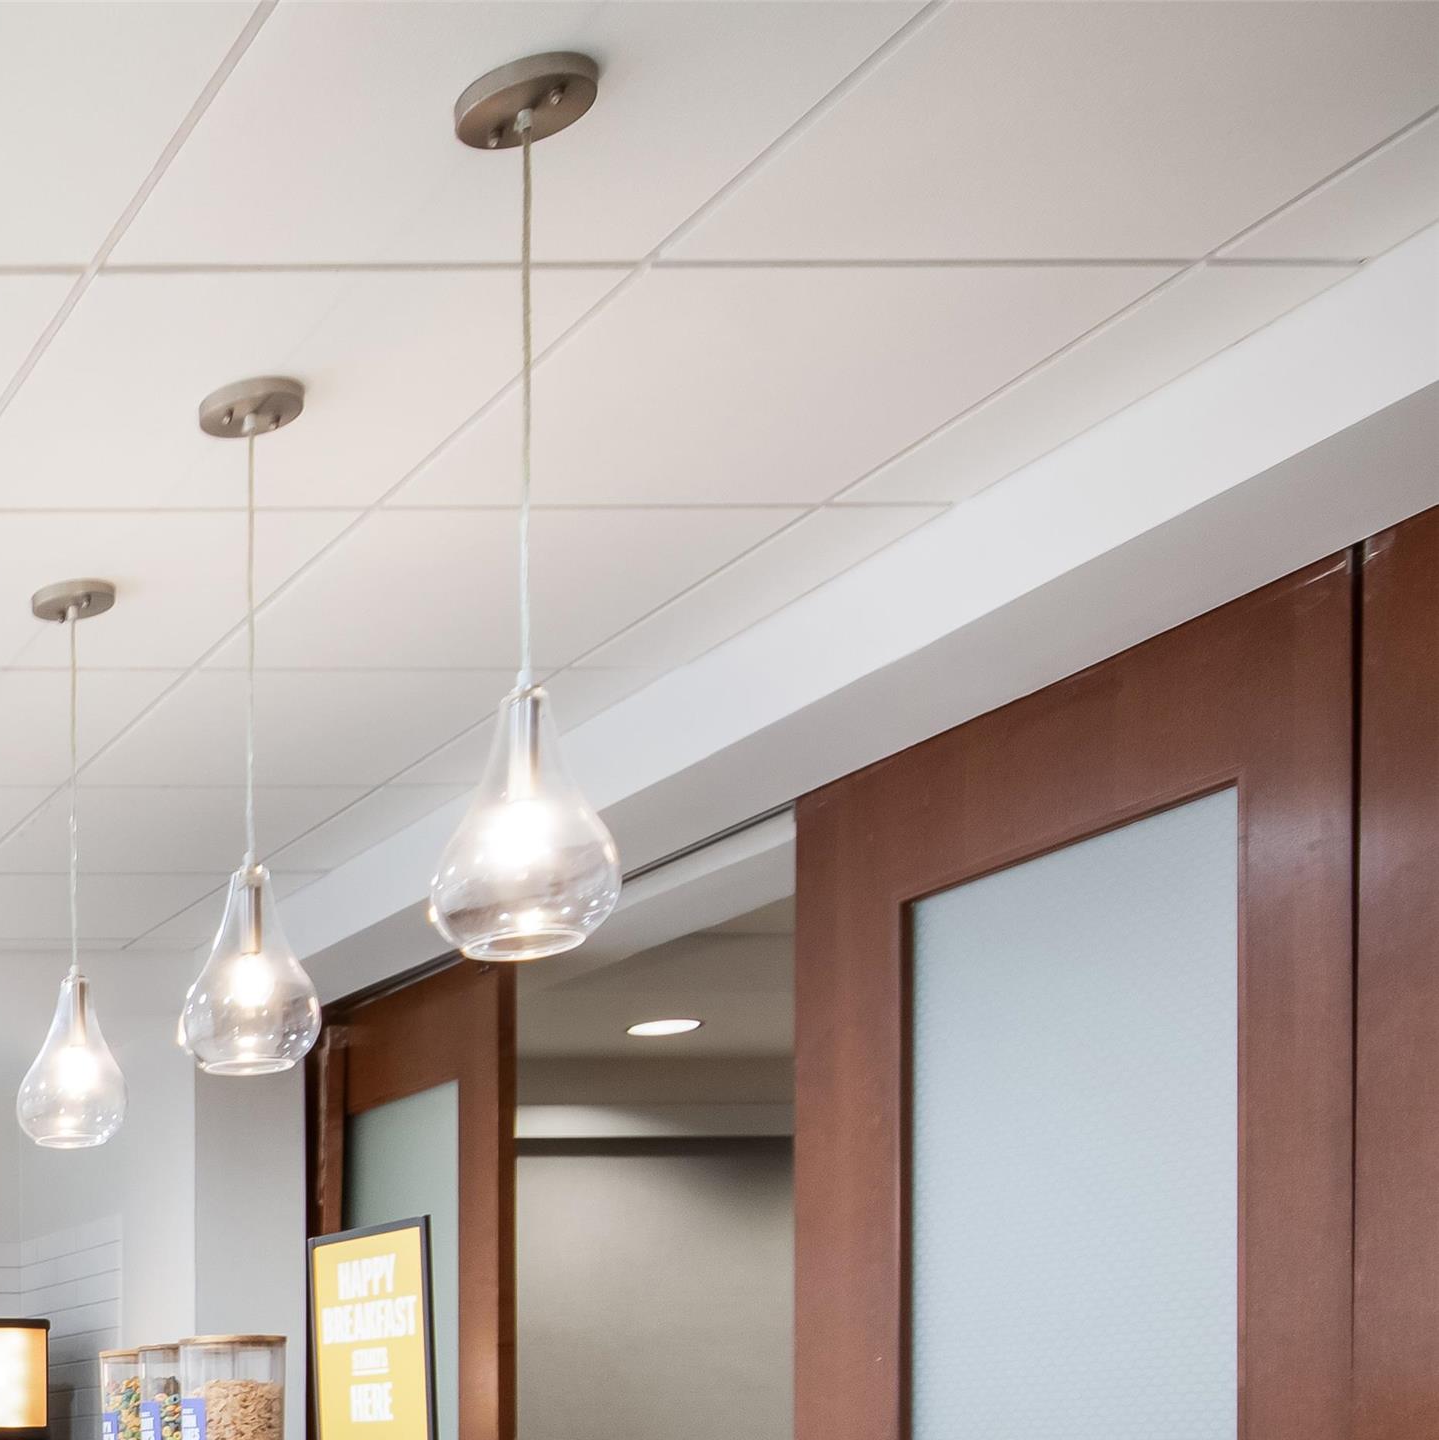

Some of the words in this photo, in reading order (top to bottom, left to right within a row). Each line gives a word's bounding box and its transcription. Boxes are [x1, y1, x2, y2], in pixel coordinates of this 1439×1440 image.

[337, 1253, 397, 1300] HAPPY
[322, 1295, 417, 1344] BREAKFAST
[350, 1381, 394, 1423] HERE
